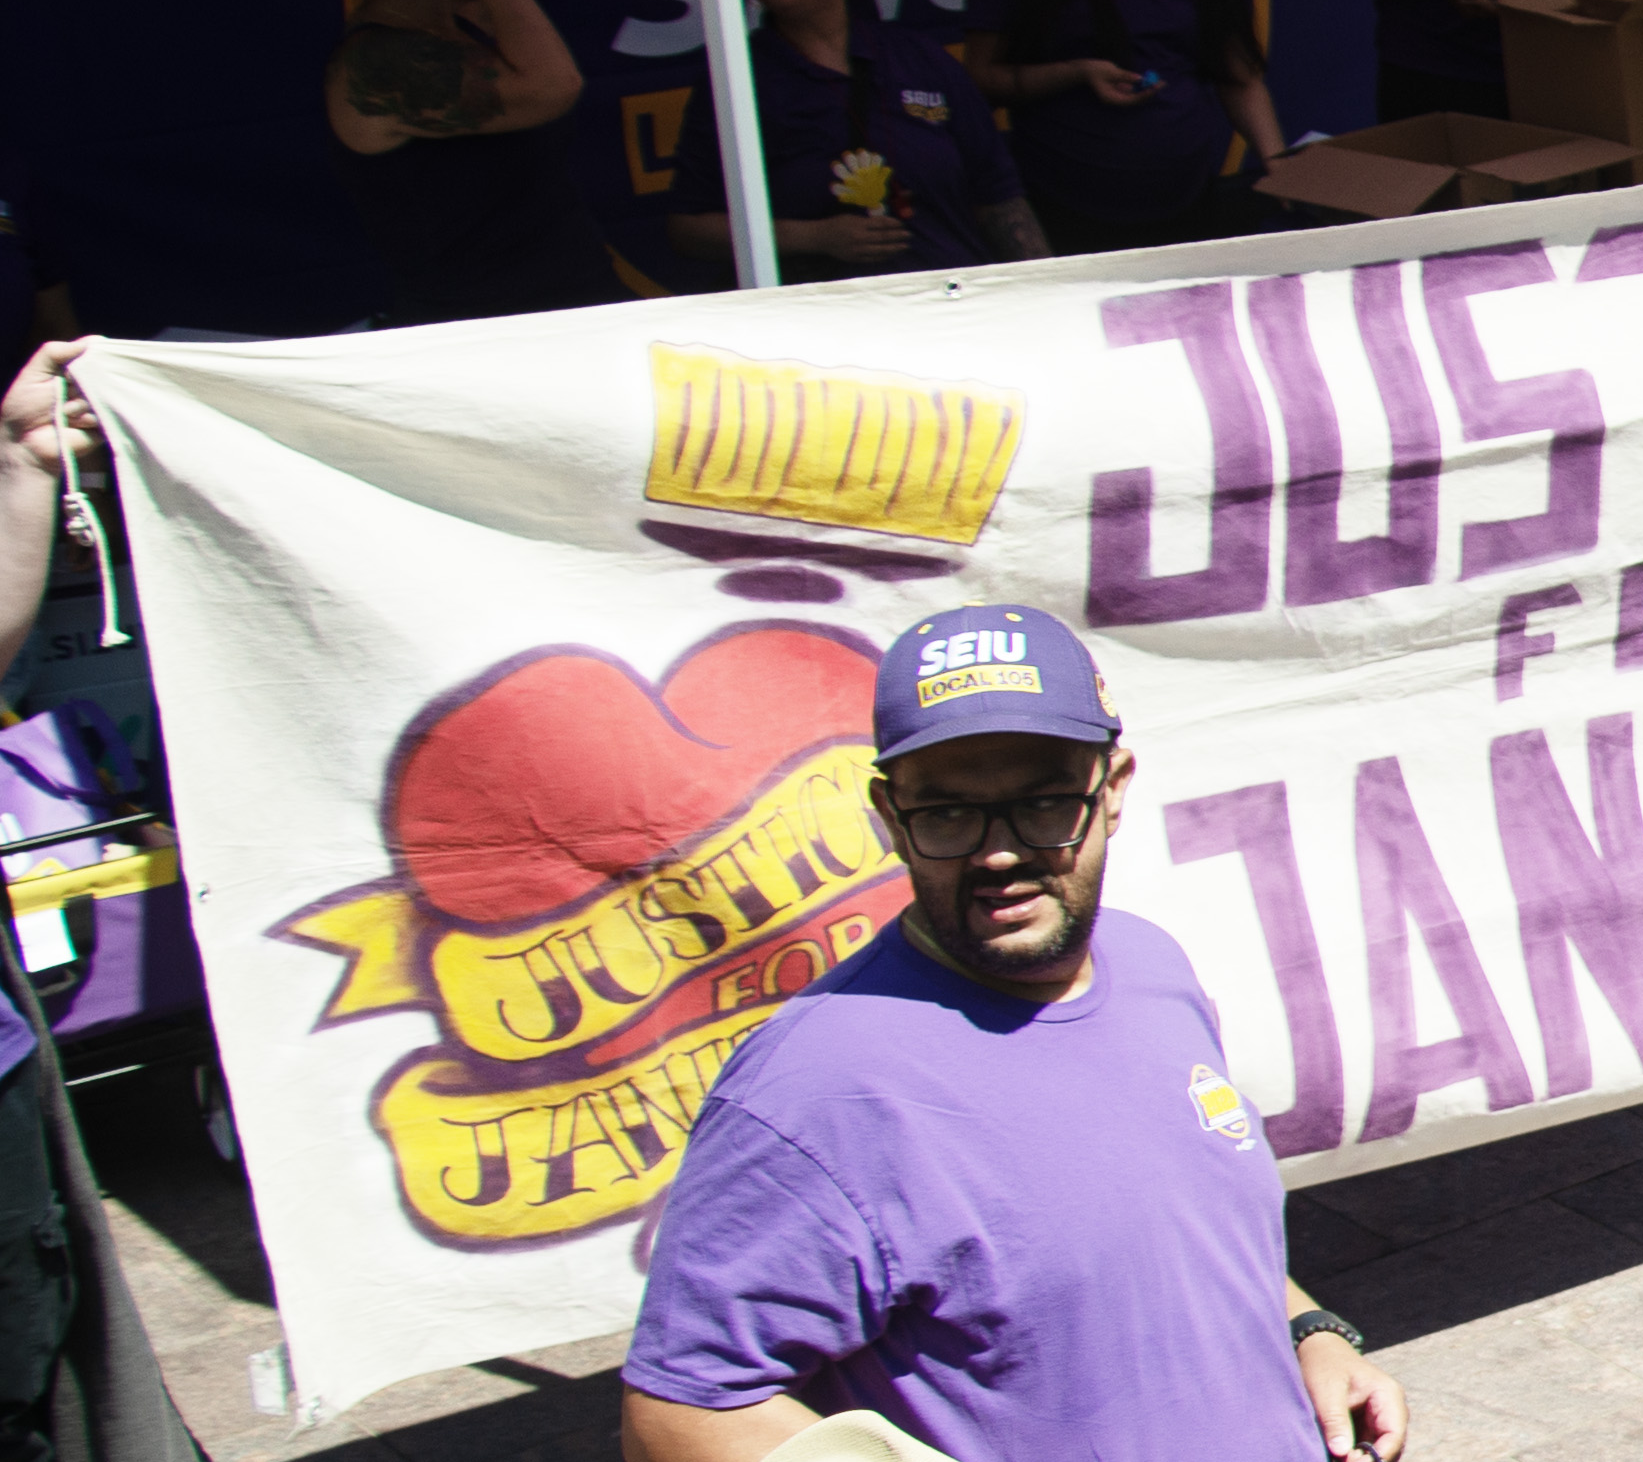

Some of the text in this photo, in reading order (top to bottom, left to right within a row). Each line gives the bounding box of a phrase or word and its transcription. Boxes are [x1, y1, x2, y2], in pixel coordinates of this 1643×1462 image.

[919, 629, 1027, 678] SEIU
[921, 669, 1036, 702] LOCAL 105
